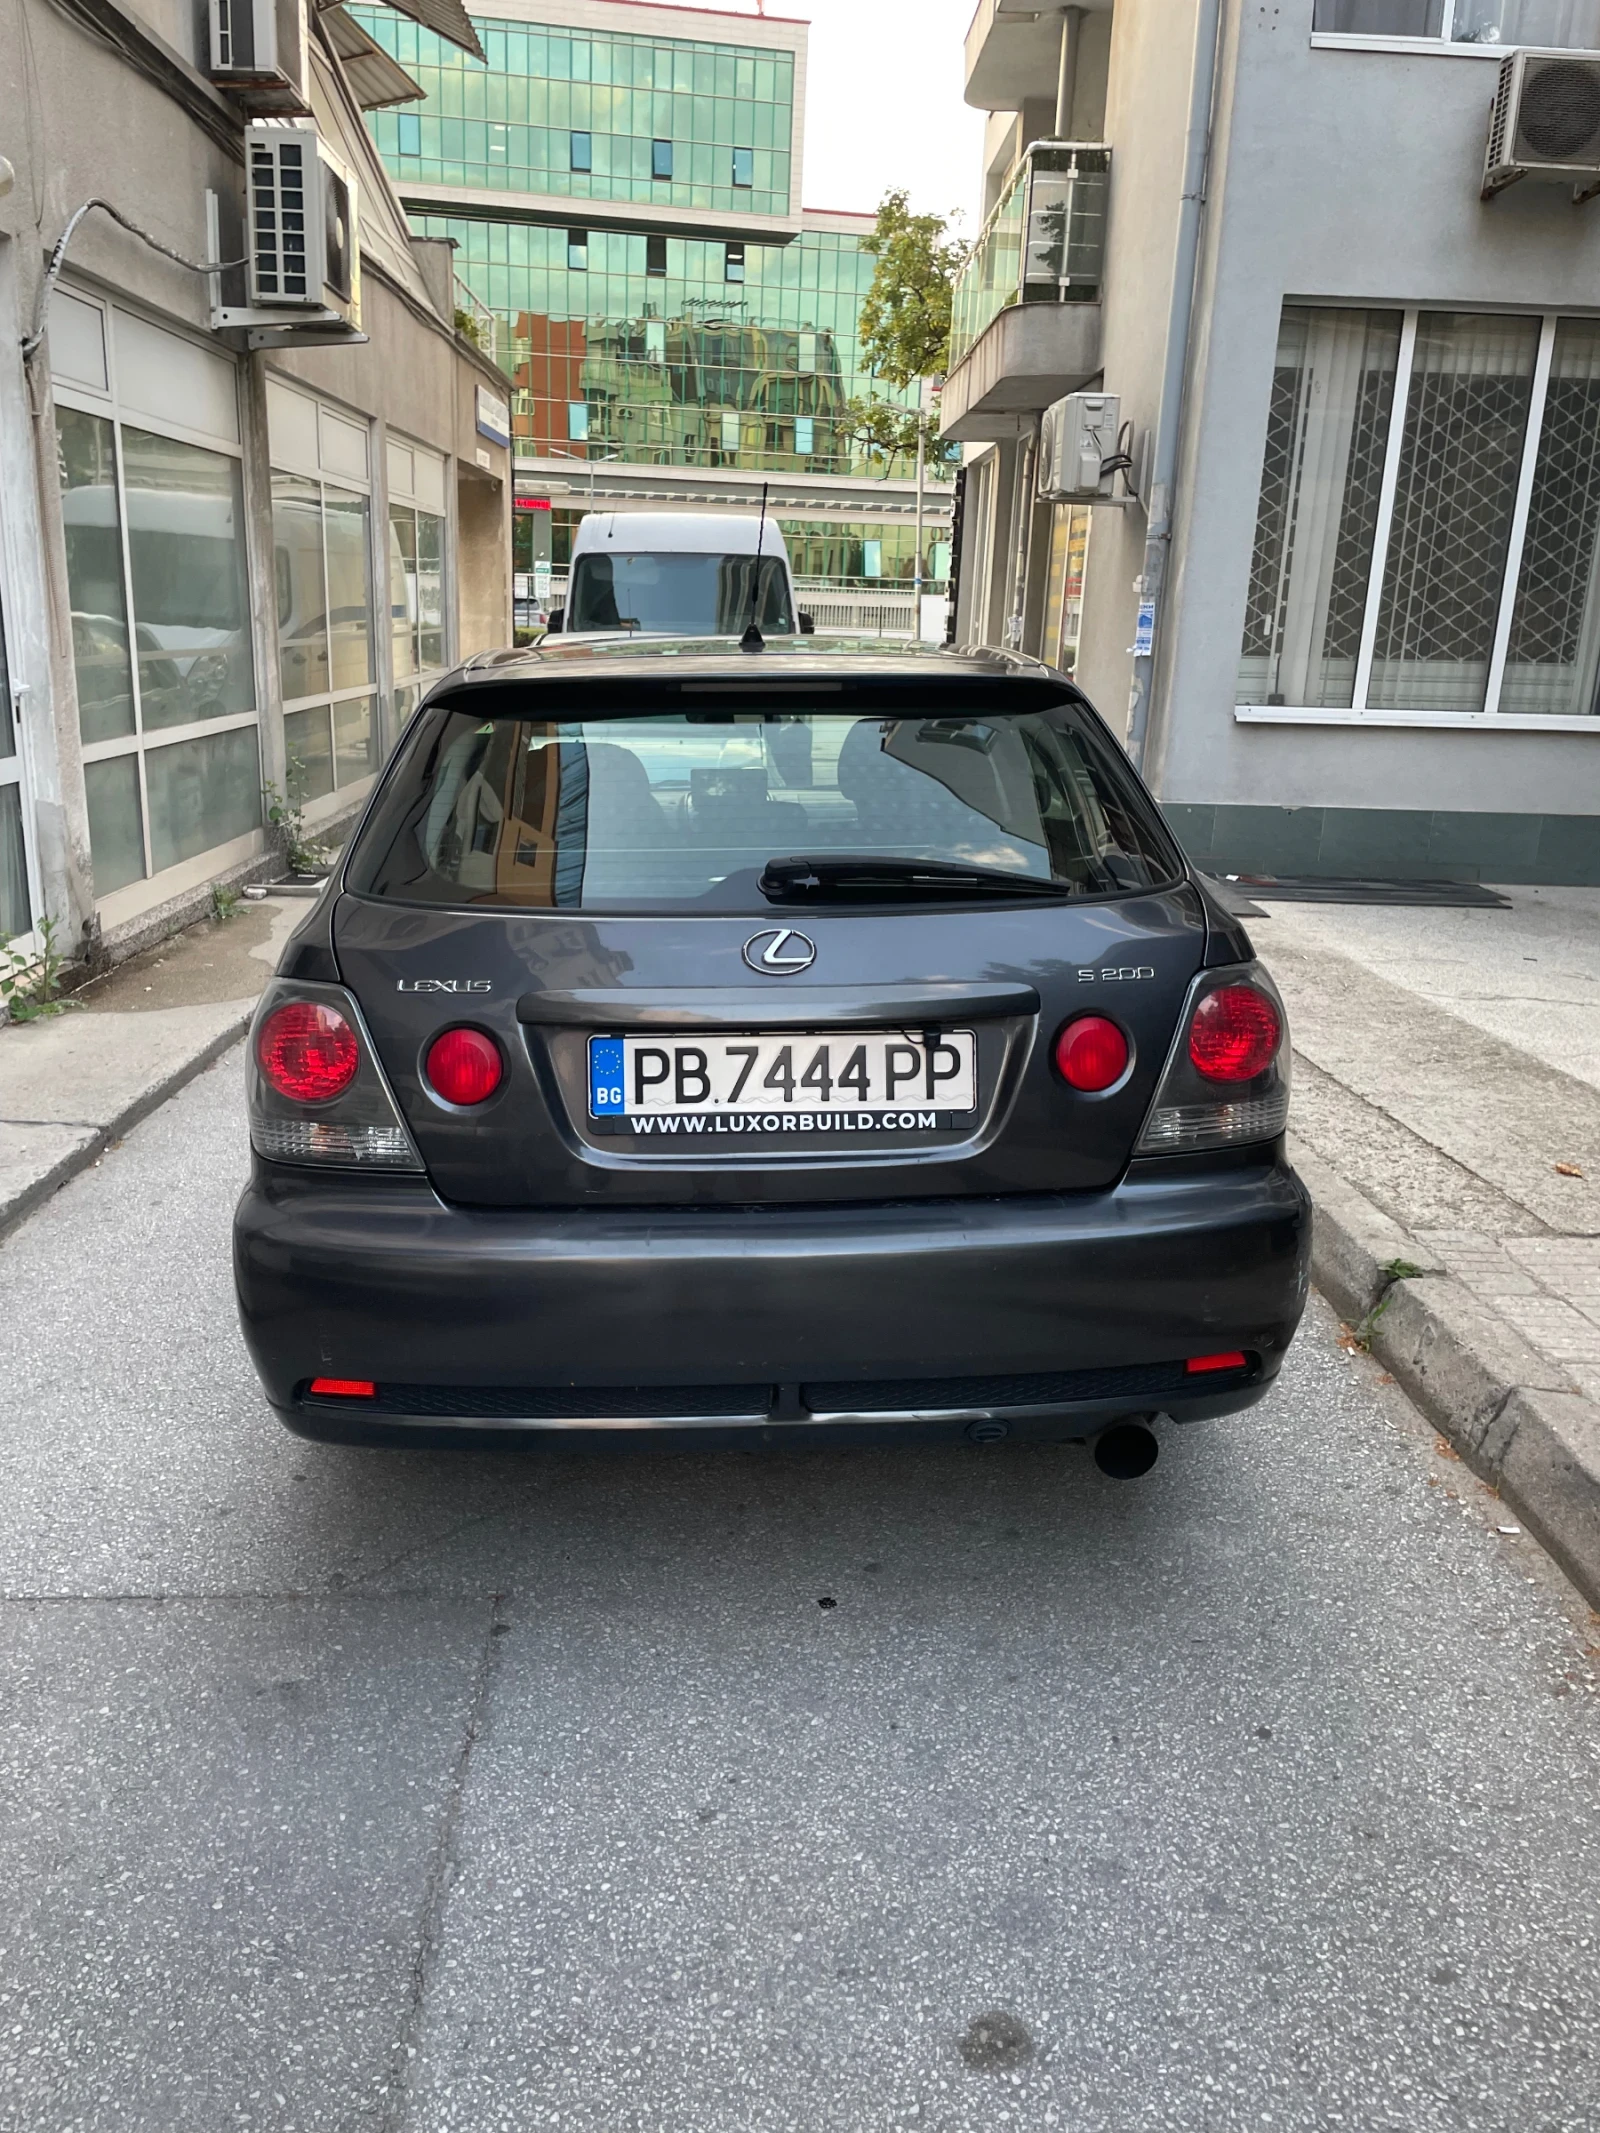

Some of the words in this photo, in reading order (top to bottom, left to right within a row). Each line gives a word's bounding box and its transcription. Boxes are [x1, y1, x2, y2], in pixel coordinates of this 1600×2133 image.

[1077, 969, 1095, 983] S
[1101, 966, 1155, 981] 200
[396, 979, 492, 993] LEXUS
[596, 1087, 622, 1104] BG
[630, 1111, 938, 1135] WWW.LUXORBUILD.COM
